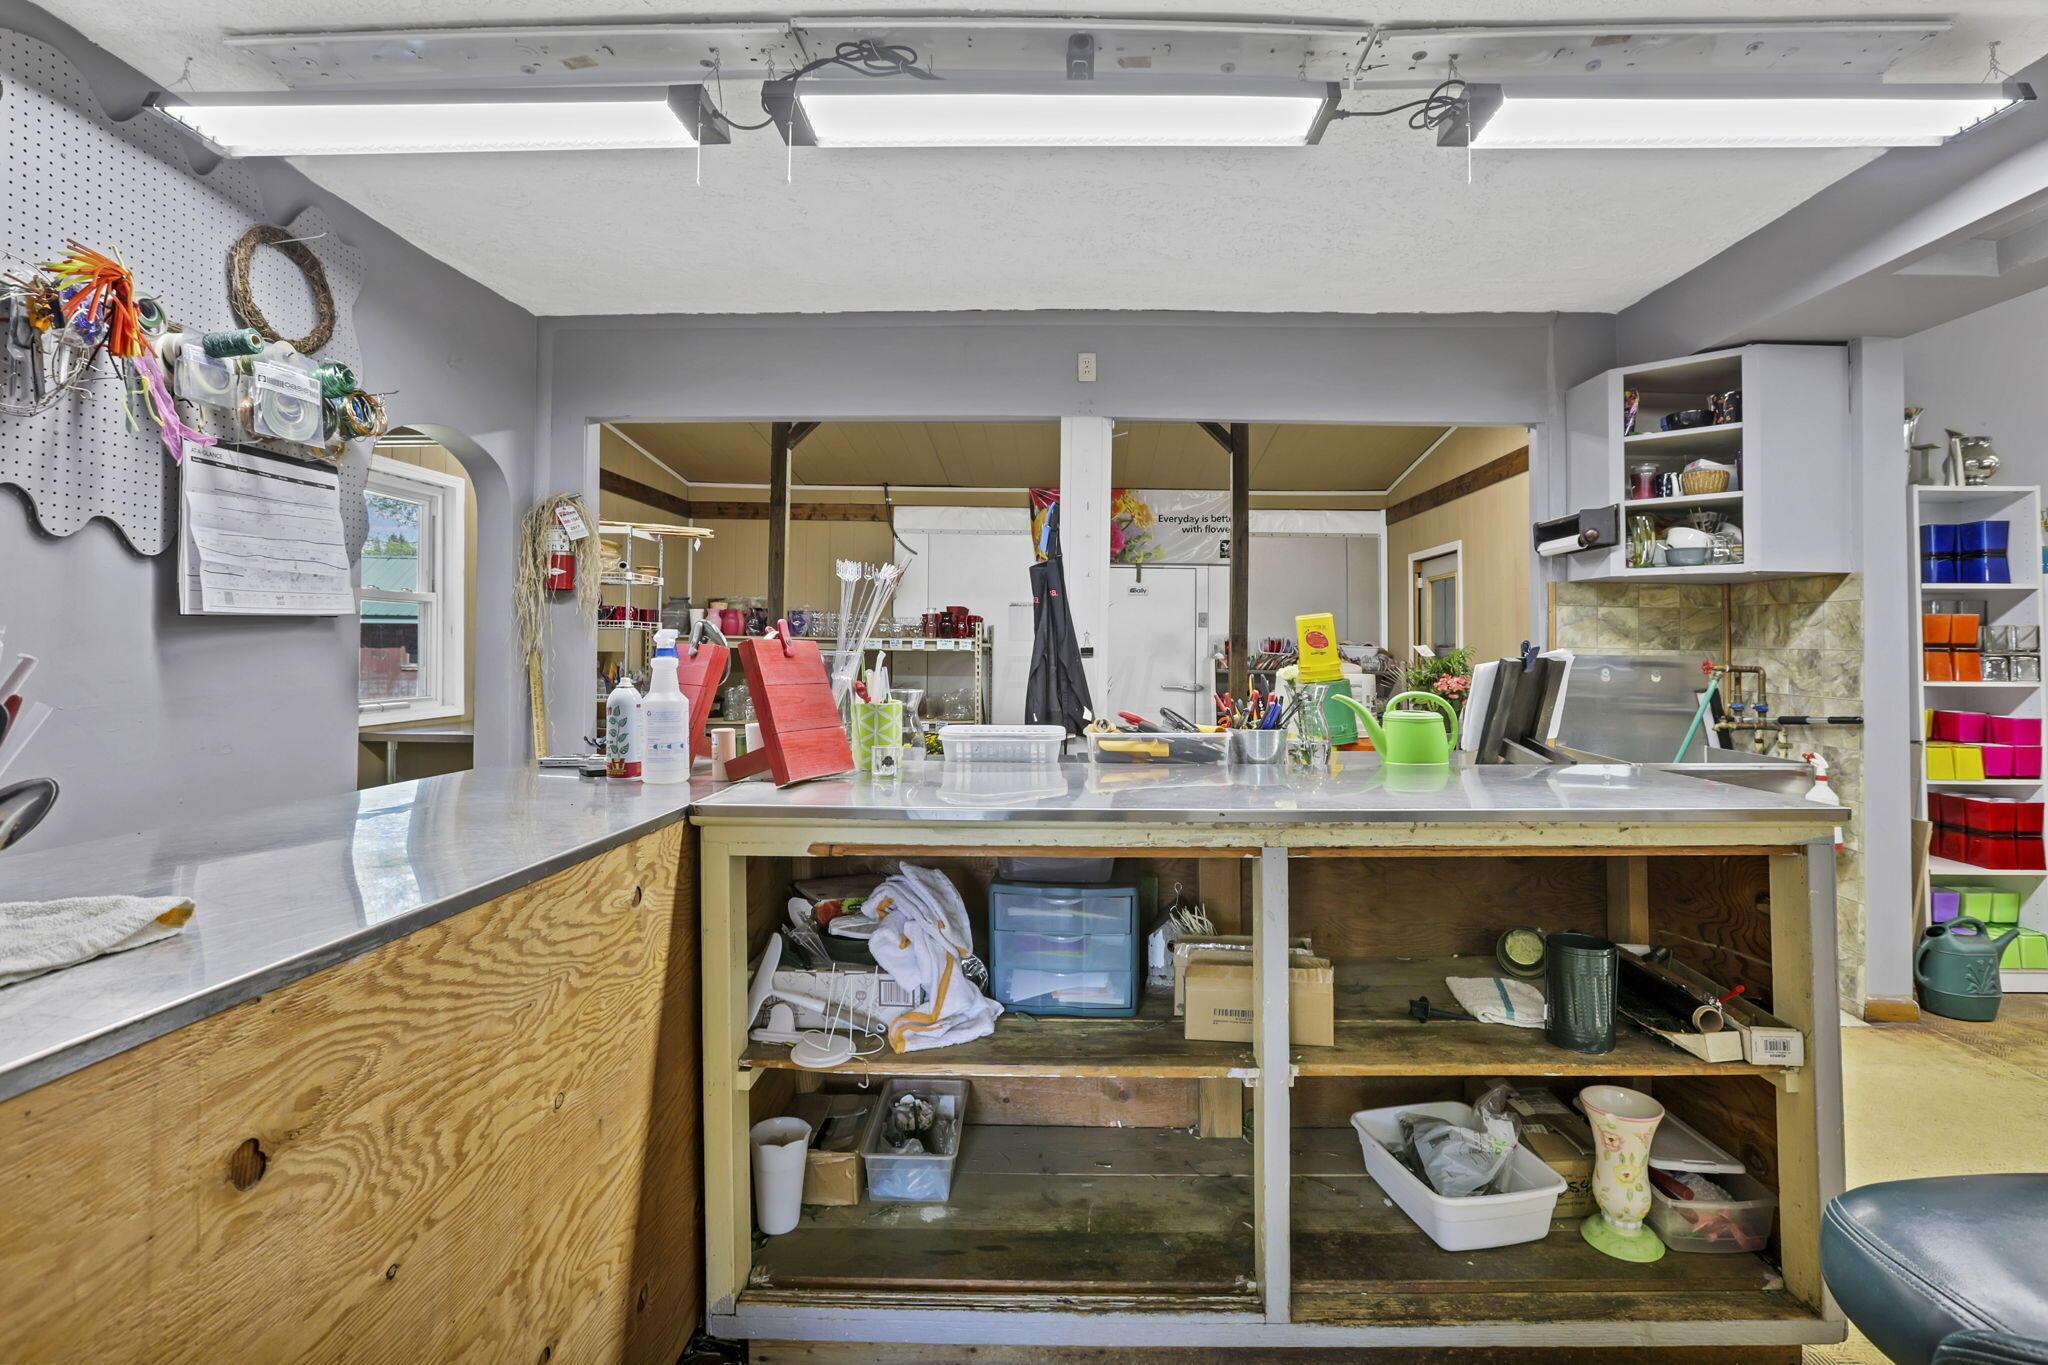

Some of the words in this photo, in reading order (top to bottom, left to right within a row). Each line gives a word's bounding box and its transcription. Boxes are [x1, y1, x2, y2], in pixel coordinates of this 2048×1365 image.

[1158, 514, 1200, 525] Everyday
[1202, 514, 1209, 523] is
[1182, 525, 1203, 533] with
